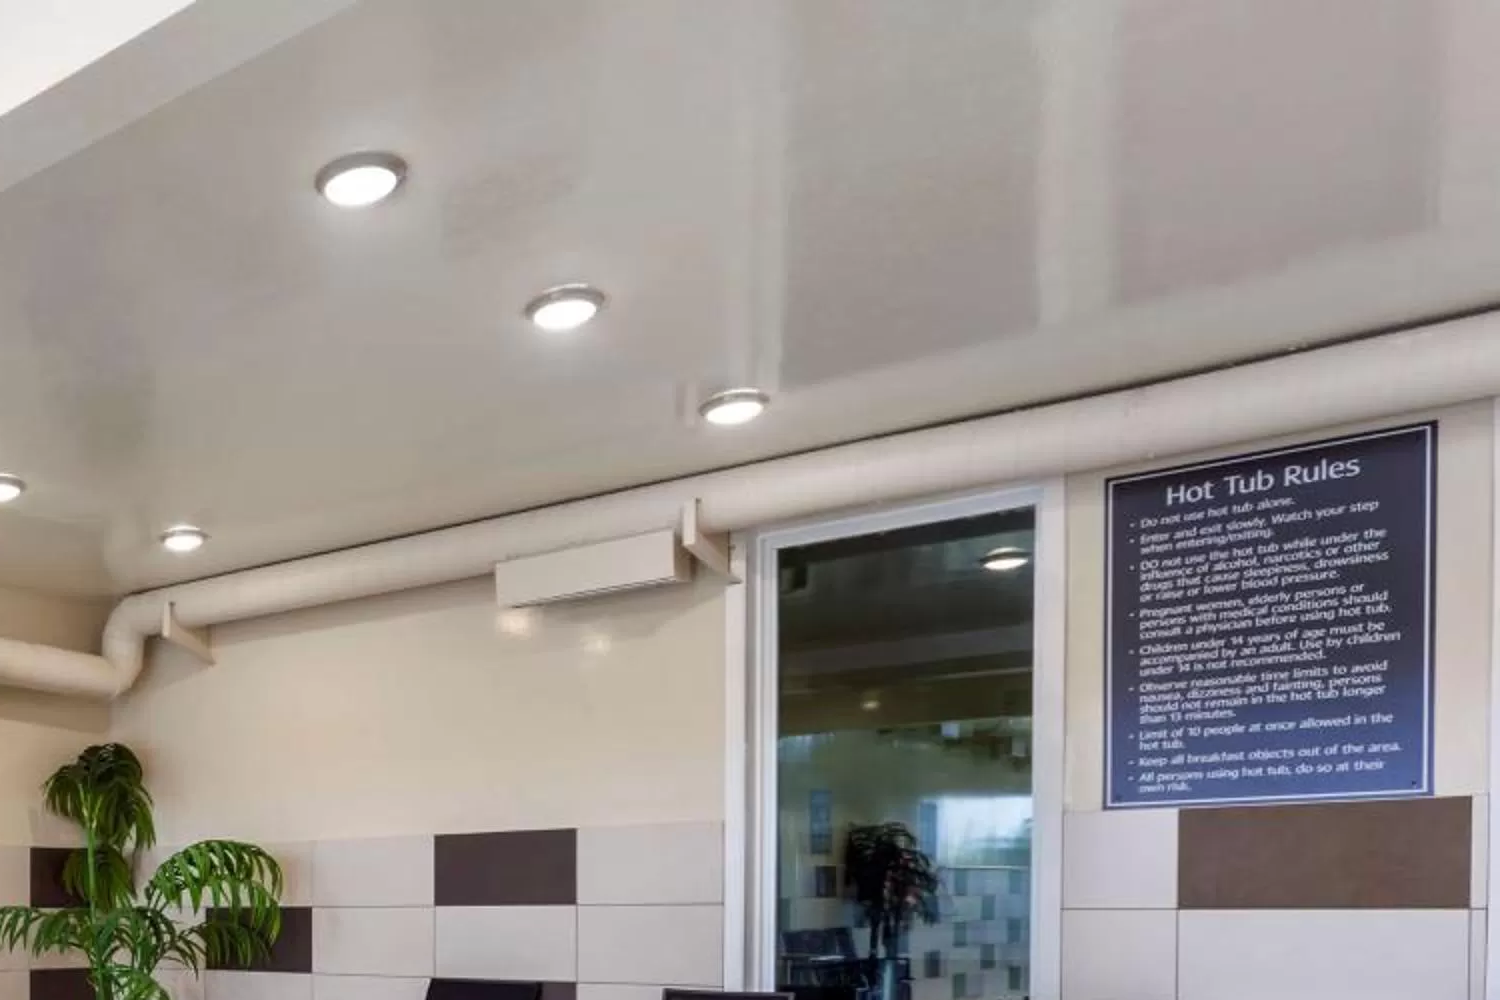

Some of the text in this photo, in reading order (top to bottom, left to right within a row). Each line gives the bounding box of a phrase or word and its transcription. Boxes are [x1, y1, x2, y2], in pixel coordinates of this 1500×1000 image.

[1166, 459, 1359, 504] Hot Tub Rules
[1140, 532, 1170, 543] Enter
[1173, 527, 1196, 538] and
[1199, 523, 1221, 535] exit
[1271, 509, 1312, 523] Watch
[1315, 506, 1346, 519] your
[1349, 501, 1379, 512] step
[1160, 513, 1179, 524] not
[1183, 511, 1204, 521] use
[1207, 506, 1227, 517] hot
[1231, 502, 1253, 513] tub
[1140, 544, 1172, 554] when
[1161, 556, 1181, 567] not
[1184, 554, 1206, 564] use
[1208, 550, 1229, 560] the
[1232, 545, 1253, 557] hot
[1257, 542, 1278, 553] tub
[1282, 537, 1316, 549] while
[1319, 532, 1358, 544] under
[1363, 527, 1386, 538] the
[1140, 567, 1193, 581] influence
[1196, 563, 1208, 573] of
[1263, 549, 1321, 563] narcotics
[1325, 546, 1340, 555] or
[1343, 541, 1380, 552] other
[1140, 580, 1173, 591] drugs
[1177, 575, 1200, 586] that
[1203, 571, 1240, 582] cause
[1314, 551, 1388, 568] drowsiness
[1139, 594, 1152, 602] or
[1186, 588, 1200, 596] or
[1203, 583, 1236, 594] lower
[1241, 576, 1278, 589] blood
[1139, 603, 1192, 618] Pregnant
[1247, 592, 1290, 605] elderly
[1295, 586, 1346, 601] persons
[1350, 584, 1364, 592] or
[1139, 591, 1388, 630] persons with medical conditions should
[1139, 626, 1180, 639] consult
[1195, 620, 1252, 635] physician
[1255, 615, 1296, 626] before
[1299, 610, 1335, 621] using
[1338, 605, 1360, 617] hot
[1139, 620, 1385, 655] Children under 14 years of age must be
[1139, 649, 1218, 666] accompanied
[1221, 648, 1236, 659] by
[1239, 647, 1256, 655] an
[1299, 640, 1323, 649] Use
[1326, 637, 1342, 648] by
[1346, 632, 1400, 644] children
[1139, 666, 1173, 676] under
[1179, 663, 1190, 672] 14
[1193, 662, 1205, 671] is
[1206, 659, 1226, 669] not
[1190, 673, 1256, 687] reasonable
[1260, 671, 1290, 681] time
[1293, 666, 1328, 678] limits
[1333, 665, 1347, 674] to
[1351, 660, 1388, 672] avoid
[1139, 685, 1385, 713] should not remain in the hot tub longer
[1187, 687, 1241, 698] dizziness
[1244, 682, 1268, 693] and
[1328, 674, 1382, 688] persons
[1139, 713, 1393, 739] Limit of 10 people at once allowed in the
[1140, 714, 1167, 724] than
[1139, 740, 1158, 750] hot
[1139, 757, 1167, 766] Keep
[1171, 754, 1184, 764] all
[1247, 747, 1294, 760] objects
[1297, 745, 1319, 756] out
[1323, 744, 1338, 754] of
[1341, 743, 1364, 753] the
[1139, 772, 1154, 781] All
[1156, 771, 1204, 783] persons
[1206, 767, 1238, 779] using
[1241, 765, 1263, 775] hot
[1295, 763, 1313, 772] do
[1316, 763, 1332, 771] so
[1335, 760, 1349, 770] at
[1353, 758, 1385, 769] their
